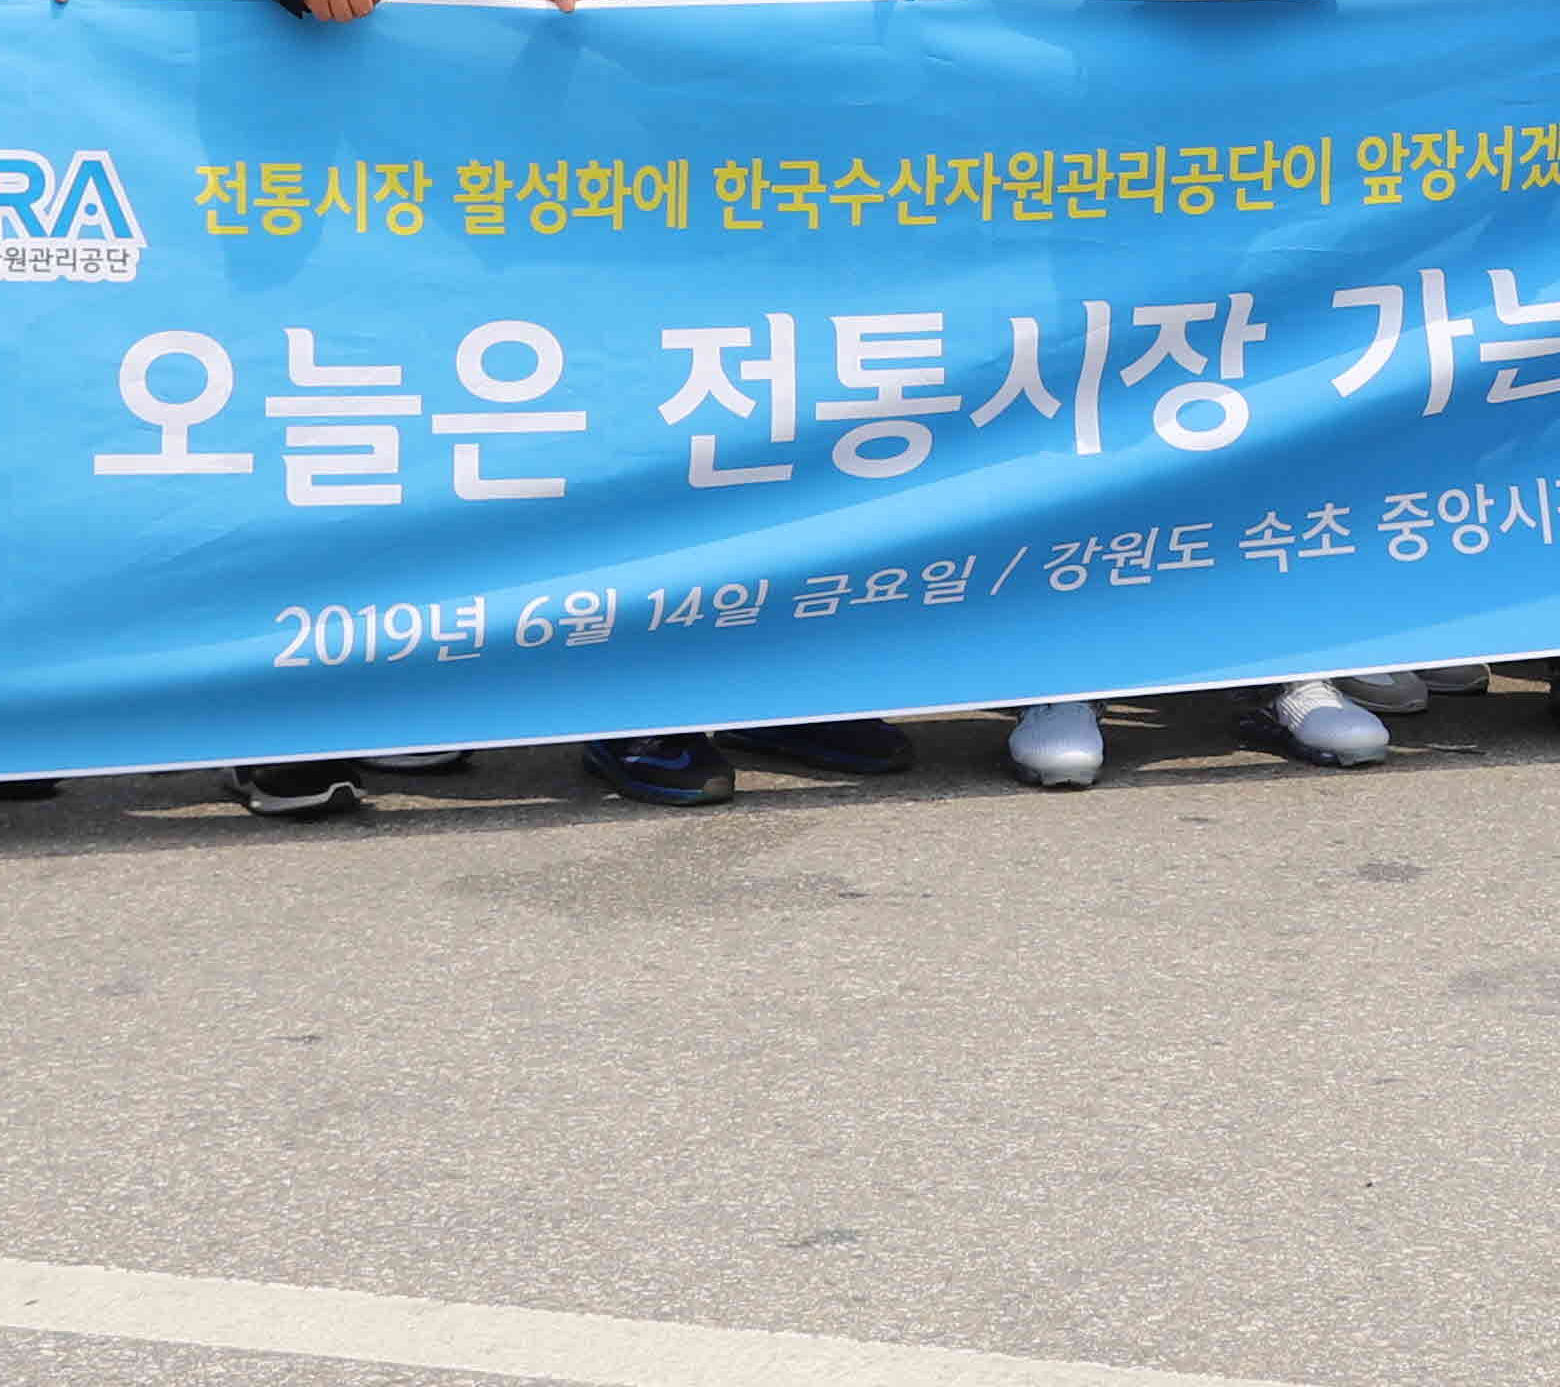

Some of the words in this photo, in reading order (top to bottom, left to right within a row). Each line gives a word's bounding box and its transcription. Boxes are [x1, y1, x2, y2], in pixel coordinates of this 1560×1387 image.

[192, 158, 430, 239] 전통시장
[451, 155, 690, 233] 활성화에
[712, 136, 1335, 231] 한국수산자원관리공단이
[93, 319, 588, 507] 오늘은
[659, 293, 1266, 491] 전통시장
[273, 598, 490, 669] 2019년
[514, 589, 619, 651] 6월
[645, 579, 768, 633] 14일
[792, 556, 976, 614] 금요일
[990, 553, 1024, 597] /
[1045, 519, 1215, 593] 강원도
[1240, 503, 1356, 569] 속초
